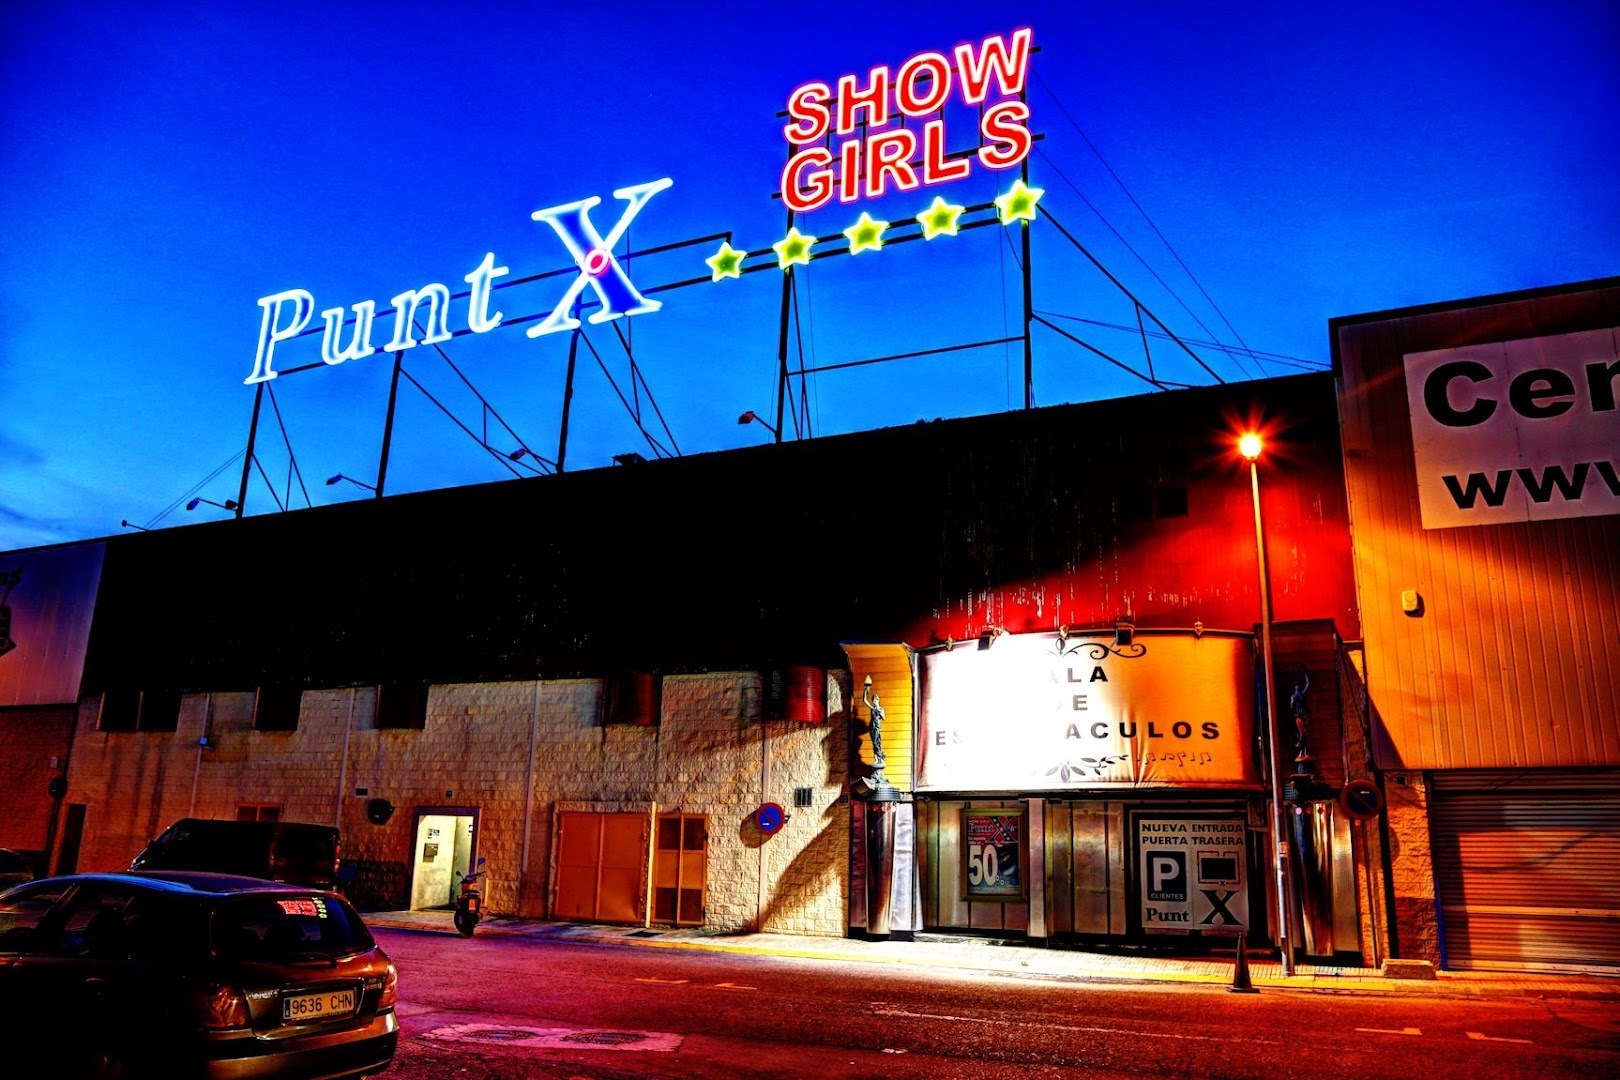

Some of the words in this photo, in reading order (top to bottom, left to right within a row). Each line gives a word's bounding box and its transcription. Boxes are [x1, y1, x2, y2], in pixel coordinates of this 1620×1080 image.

[784, 27, 1032, 144] SHOW
[781, 101, 1033, 212] GIRLS
[243, 251, 510, 385] Punt
[525, 176, 674, 340] X
[1141, 823, 1188, 833] NUEVA
[1191, 823, 1244, 833] ENTRADA
[1141, 835, 1189, 845] PUERTA
[1191, 836, 1245, 846] TRASERA
[1152, 856, 1181, 892] P
[1145, 907, 1191, 923] Punt
[1198, 889, 1244, 926] X
[1150, 892, 1185, 900] CLIENTES
[291, 999, 323, 1015] 9636
[330, 992, 352, 1010] CHN
